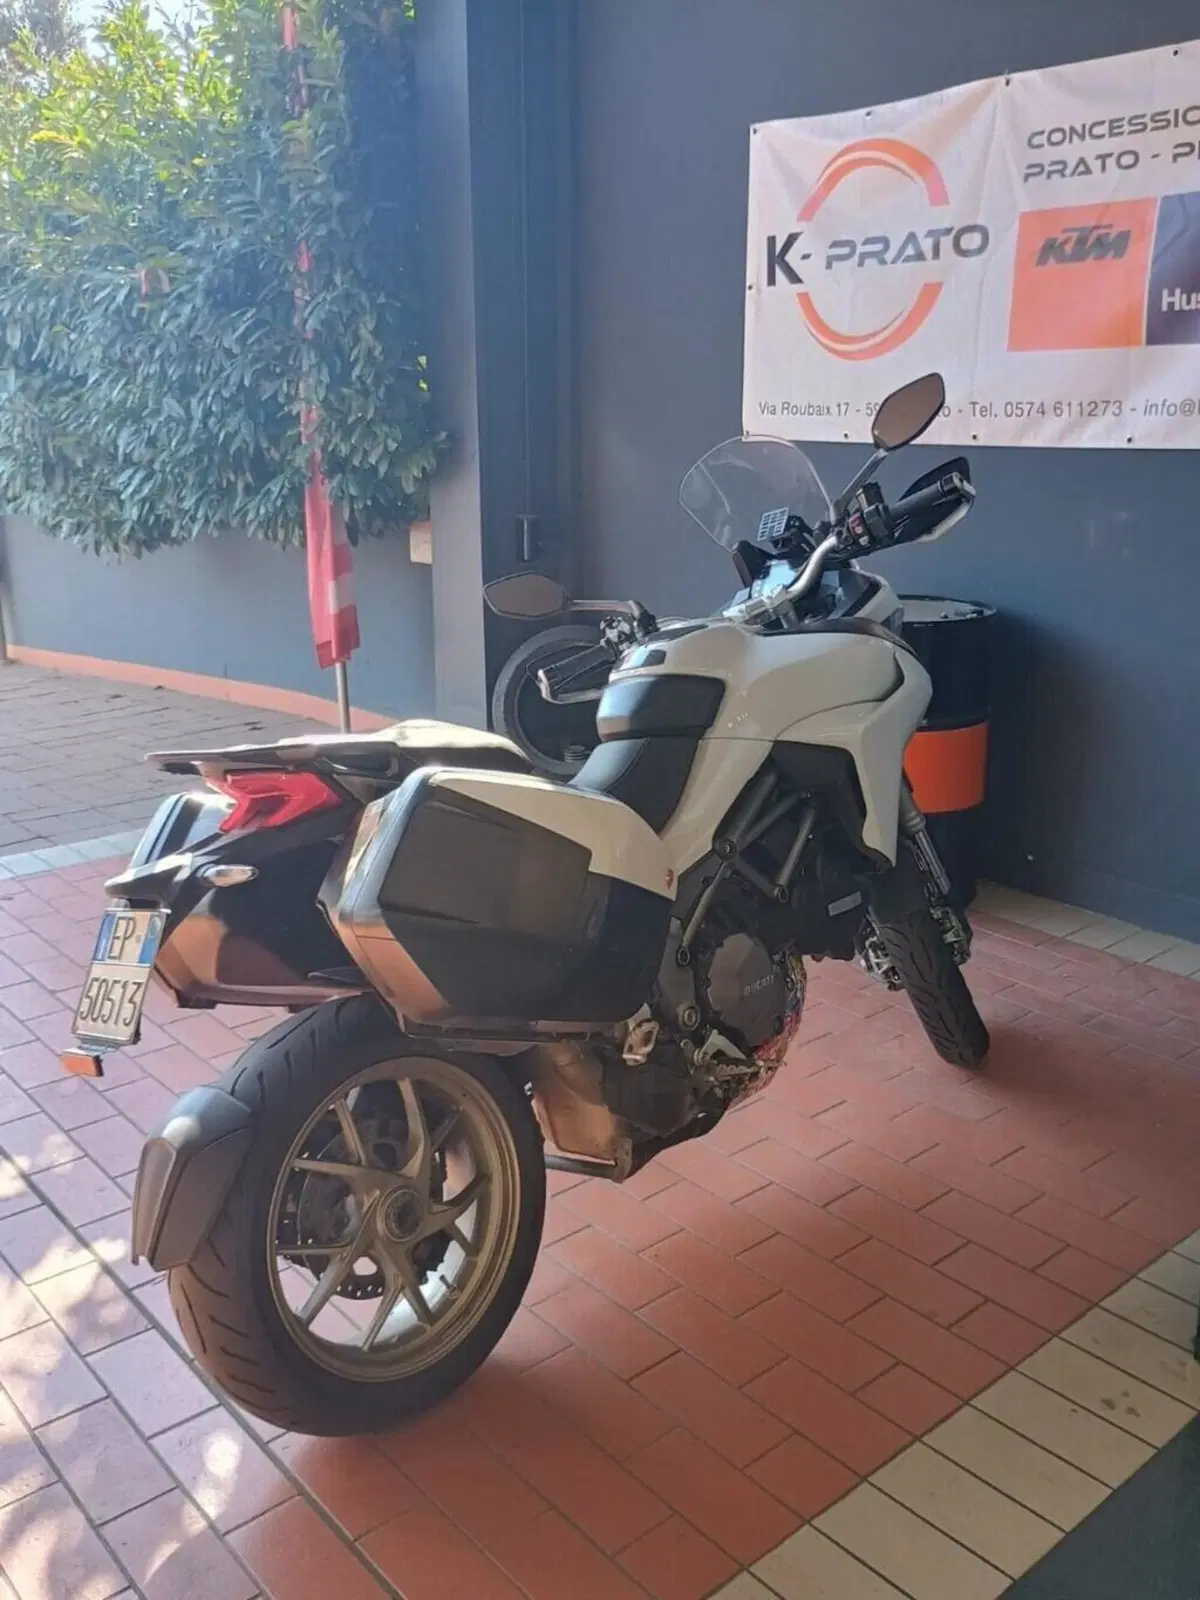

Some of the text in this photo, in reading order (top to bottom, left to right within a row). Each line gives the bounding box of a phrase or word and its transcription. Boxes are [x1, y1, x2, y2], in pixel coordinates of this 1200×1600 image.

[1022, 149, 1140, 183] PRATO
[825, 224, 990, 270] PRATO
[1035, 223, 1131, 267] KTM
[759, 402, 777, 416] Via
[781, 402, 832, 416] Roubaix
[836, 402, 849, 416] 17
[969, 401, 998, 418] Tel.
[1004, 401, 1046, 418] 0574
[1053, 400, 1123, 418] 611273
[107, 916, 136, 960] EP
[80, 977, 144, 1027] 50513
